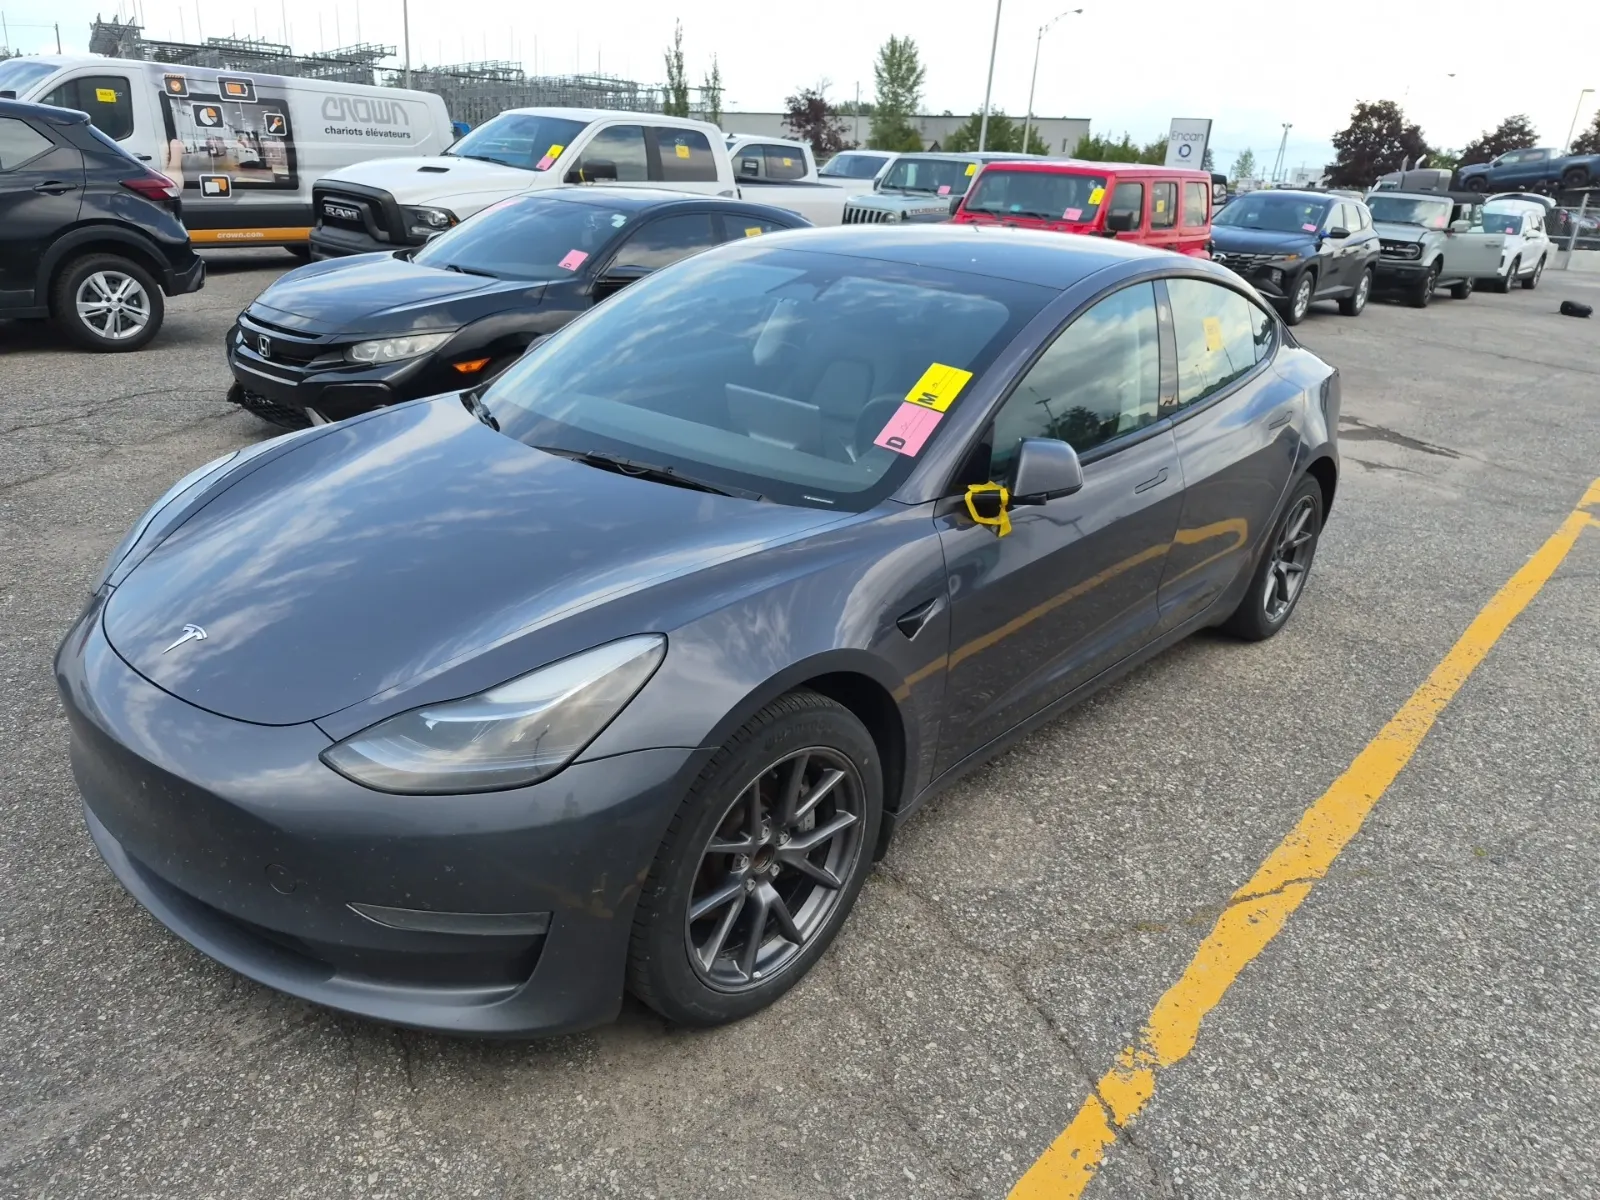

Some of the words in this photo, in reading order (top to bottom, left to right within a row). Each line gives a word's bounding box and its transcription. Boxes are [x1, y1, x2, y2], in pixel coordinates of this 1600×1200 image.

[324, 126, 363, 136] chariots
[365, 128, 411, 139] élévateurs
[1171, 131, 1204, 142] Encan
[325, 206, 358, 219] RAM
[217, 231, 264, 239] crown.com
[917, 391, 939, 405] M
[885, 436, 906, 450] D
